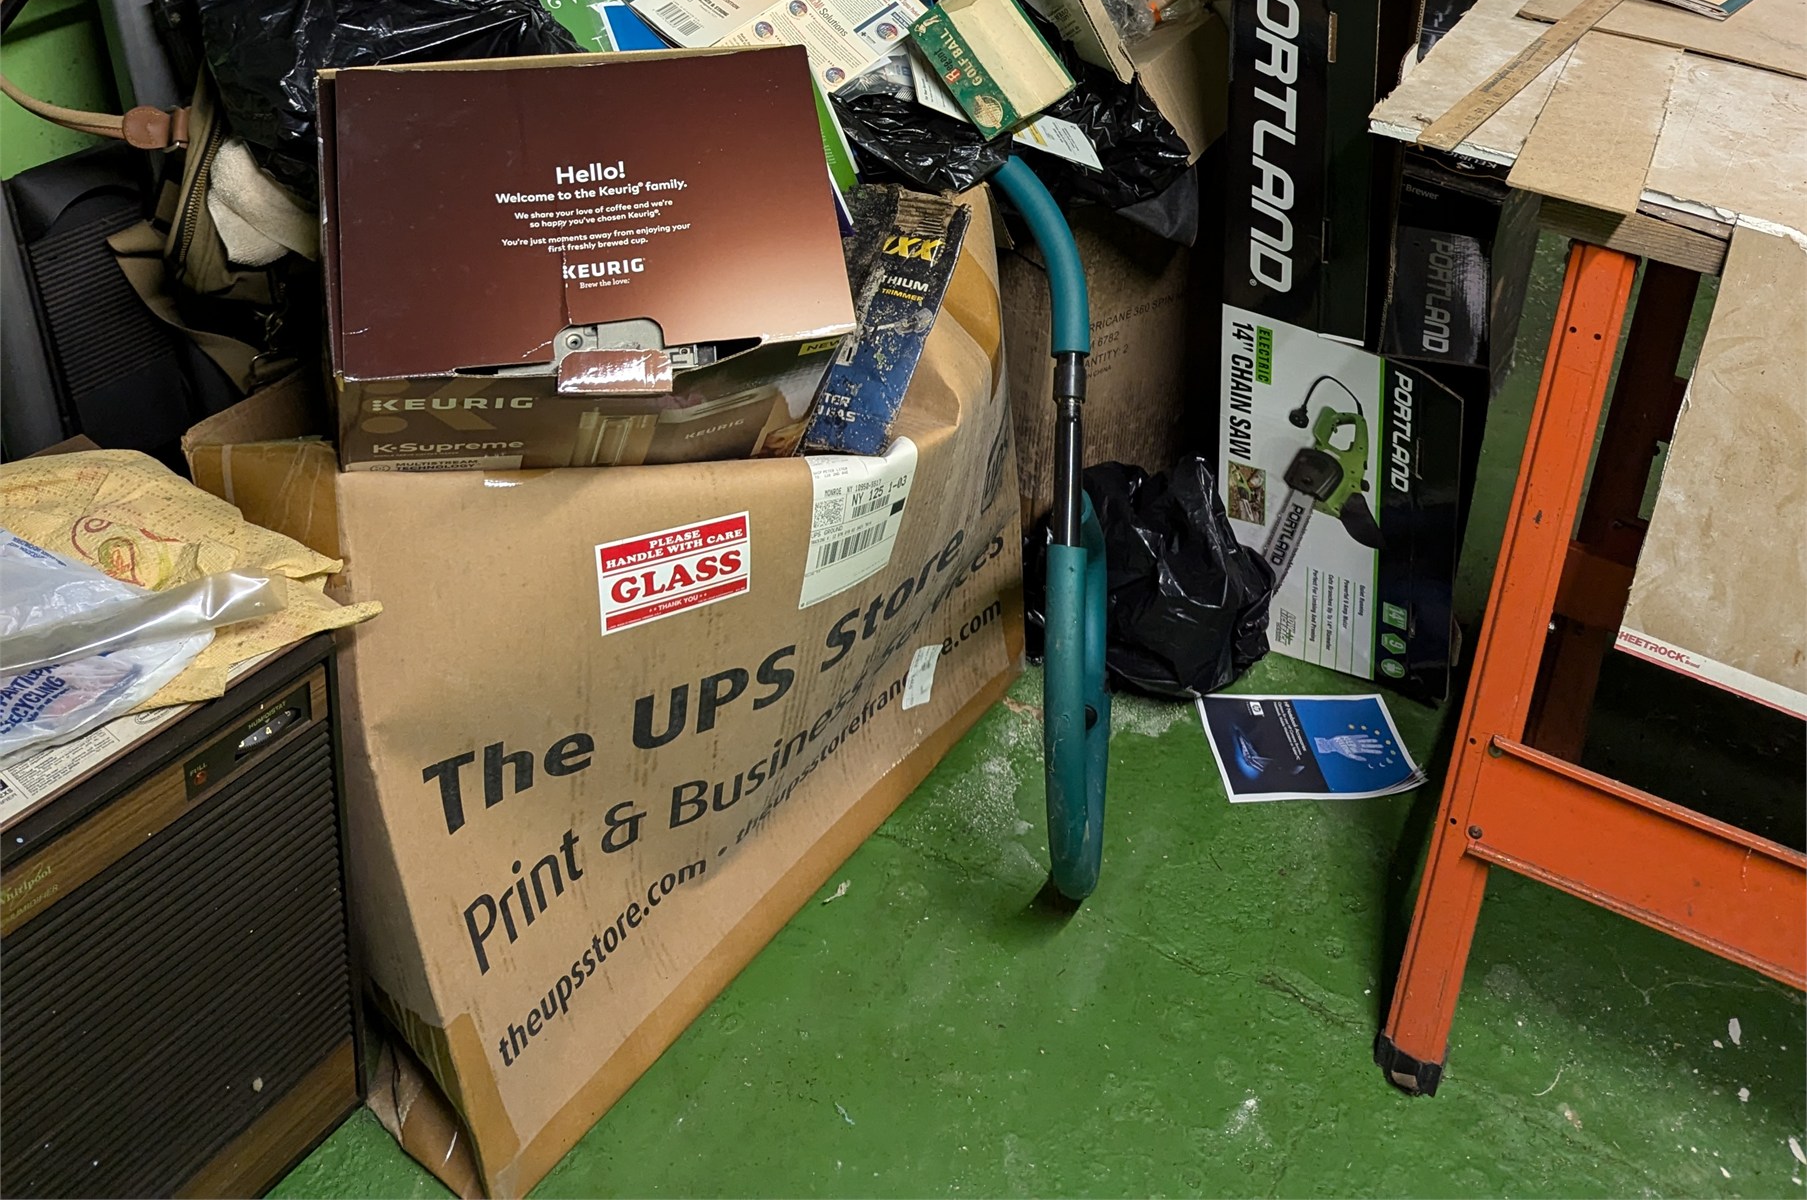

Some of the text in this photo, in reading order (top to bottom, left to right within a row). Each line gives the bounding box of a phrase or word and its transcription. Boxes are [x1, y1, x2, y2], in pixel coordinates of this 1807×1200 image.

[819, 6, 848, 38] Solutions
[938, 28, 984, 86] GOLF BALL
[555, 160, 626, 185] Hello!
[495, 192, 555, 204] Welcome
[558, 191, 572, 200] to
[574, 188, 596, 199] the
[645, 179, 688, 192] family.
[514, 199, 674, 220] We share your love of coffee and we're
[541, 219, 567, 230] happy
[568, 216, 596, 227] you've
[597, 213, 627, 223] chosen
[501, 222, 691, 247] You're just moments away from enjoying your
[548, 237, 649, 253] first freshly brewed cup.
[562, 257, 645, 280] KEURIG
[579, 278, 611, 289] Brew the
[881, 288, 925, 303] TRIMMER
[1090, 309, 1133, 333] RRICANE
[1098, 331, 1120, 347] 6782
[1123, 344, 1129, 354] 2
[1258, 328, 1272, 384] ELECTRIC
[1230, 354, 1253, 412] CHAIN
[372, 397, 533, 412] KEURIG
[685, 418, 745, 440] KEURIG
[1229, 414, 1252, 461] SAW
[1391, 370, 1413, 493] PORTLAND
[396, 459, 478, 468] MULTISTREAM
[852, 493, 864, 506] NY
[869, 488, 884, 501] 125
[649, 529, 701, 549] PLEASE
[1270, 502, 1304, 567] PORTLAND
[605, 528, 743, 569] HANDLE WITH CARE
[611, 549, 742, 604] GLASS
[658, 599, 683, 611] THANK
[683, 594, 699, 604] YOU
[1618, 631, 1686, 663] HEETROCK
[422, 731, 595, 836] The
[631, 644, 796, 750] UPS
[820, 528, 964, 674] Store
[265, 727, 272, 735] 4
[463, 827, 585, 976] Print
[600, 800, 647, 855] &
[668, 680, 865, 832] Business
[498, 859, 707, 1069] theupsstore.com
